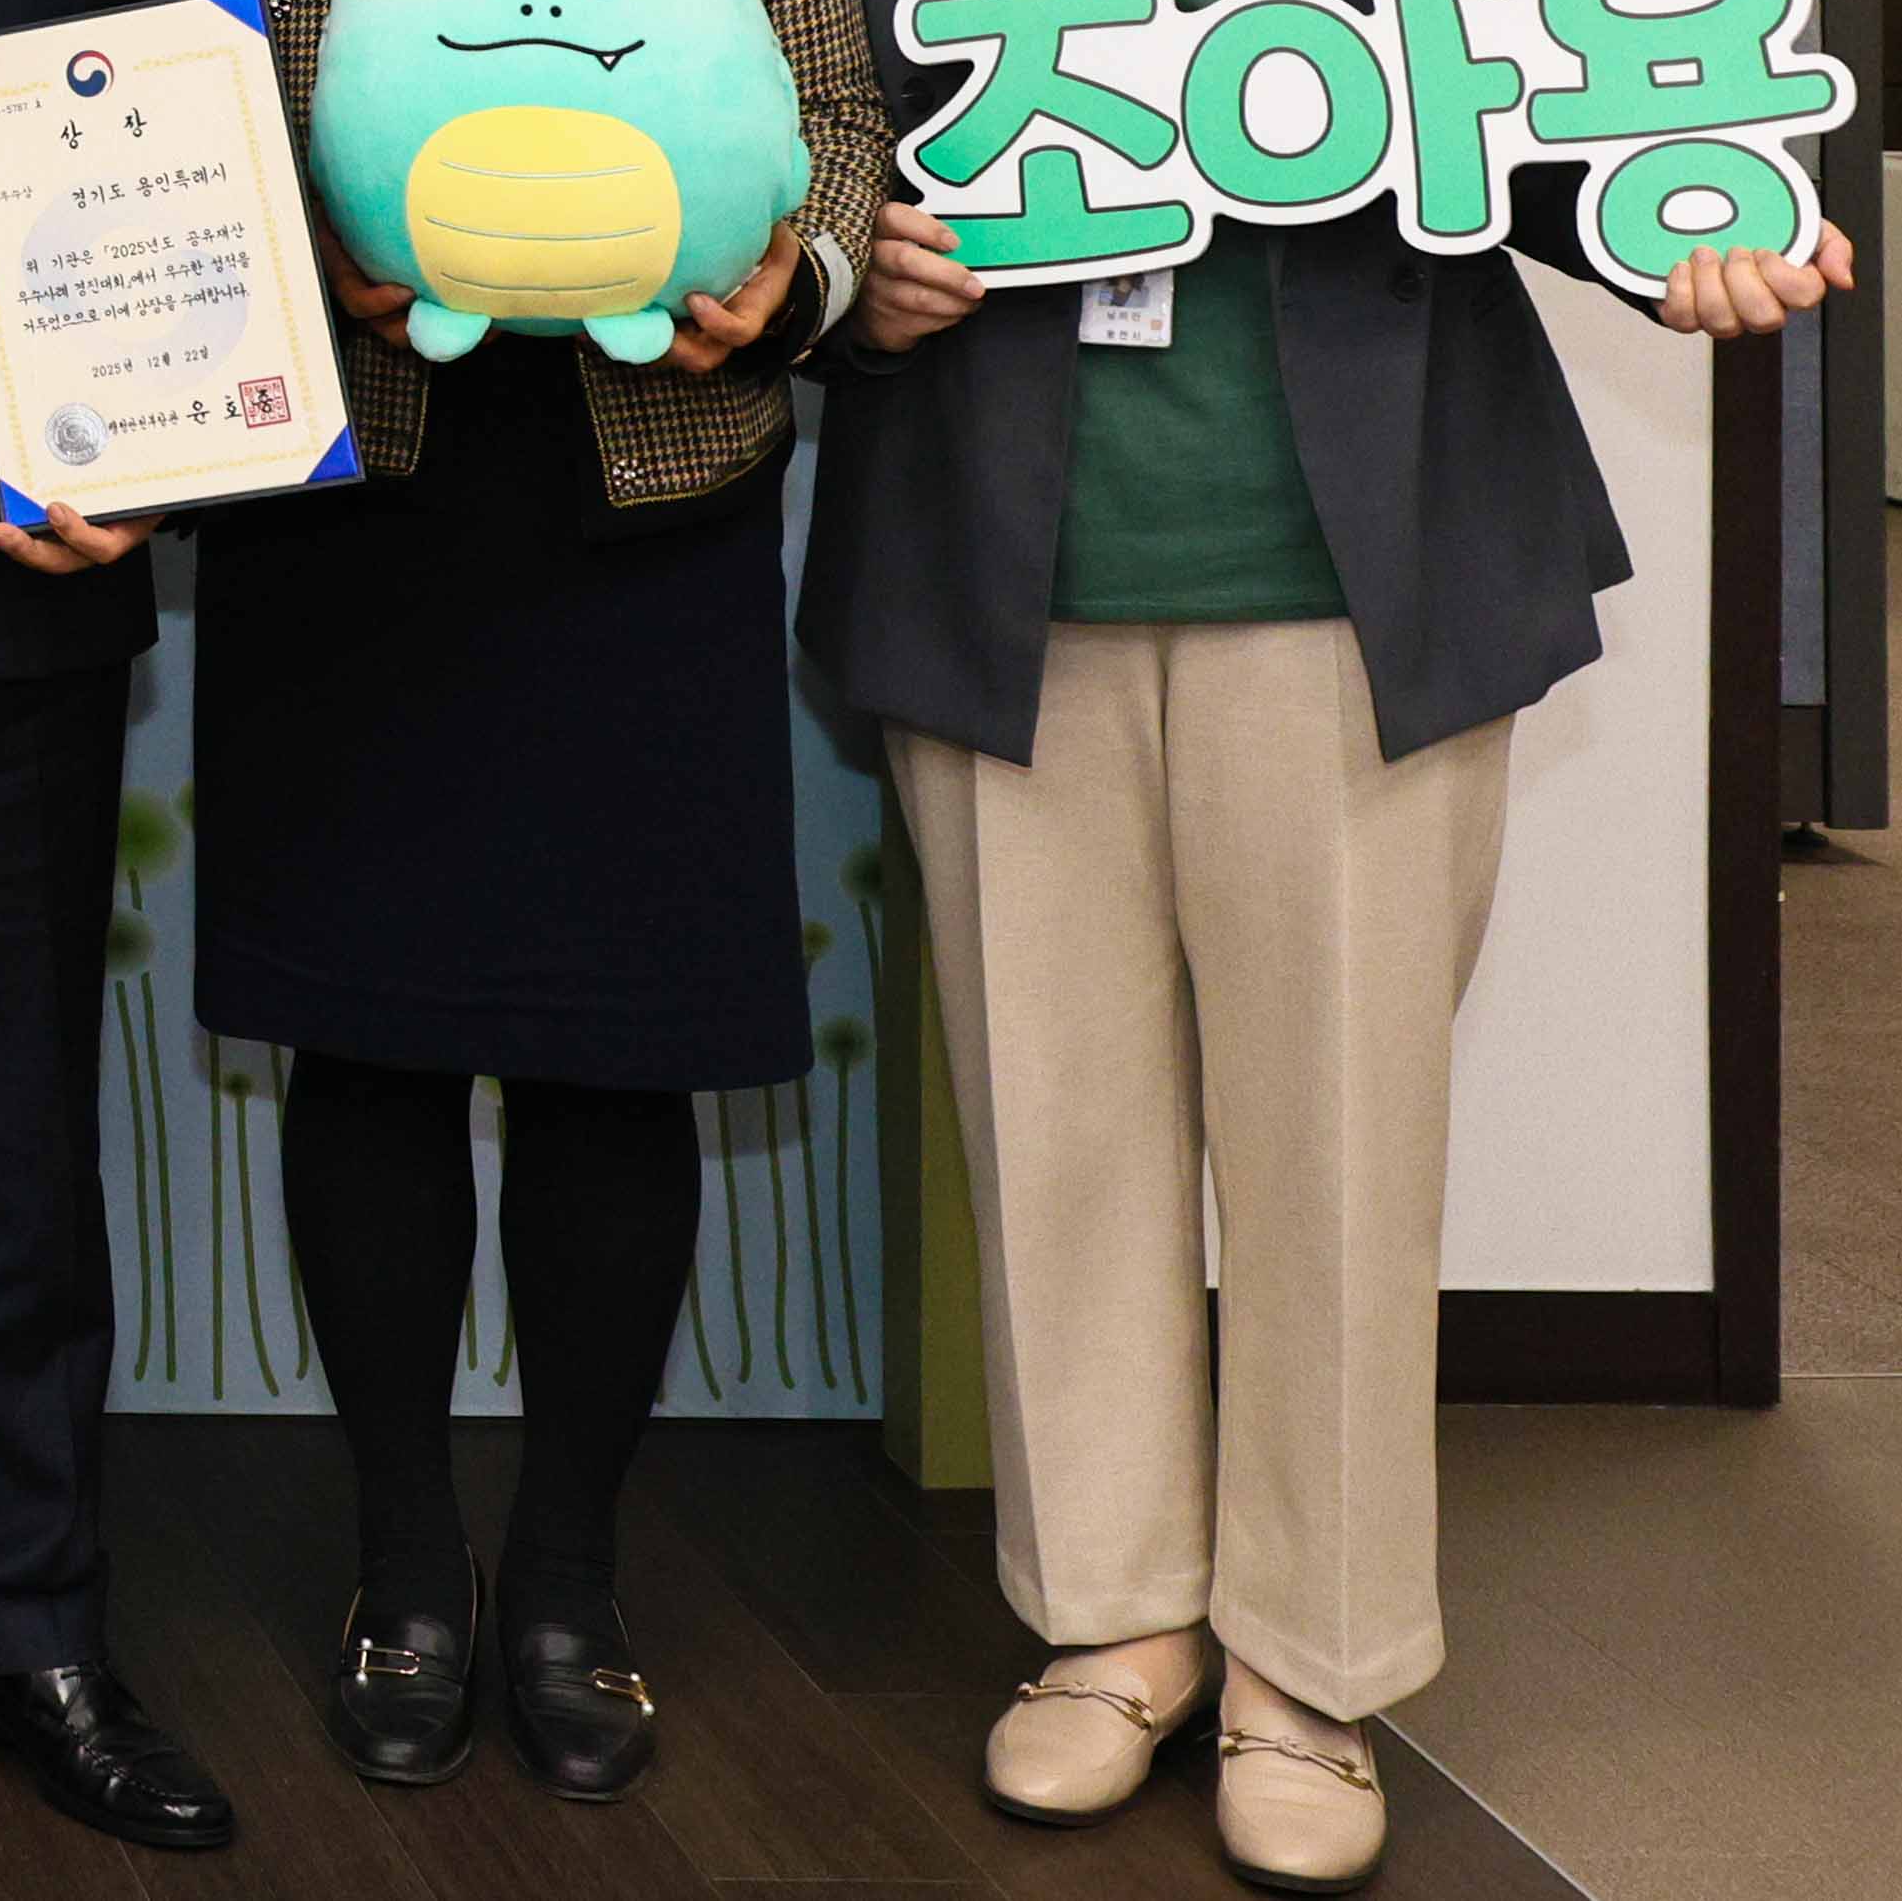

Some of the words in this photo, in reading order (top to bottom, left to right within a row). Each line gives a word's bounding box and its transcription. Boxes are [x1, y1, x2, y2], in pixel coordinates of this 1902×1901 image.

[60, 119, 83, 149] 상
[123, 107, 147, 137] 장
[71, 183, 125, 209] 경기도
[135, 162, 227, 198] 용인특례시
[26, 259, 39, 274] 위
[52, 249, 94, 269] 기관은
[186, 221, 245, 247] 공유재산
[17, 285, 69, 306] 우수사례
[164, 259, 205, 279] 우수한
[22, 308, 101, 334] 거두었으므로
[104, 304, 131, 320] 이에
[135, 294, 177, 316] 상장을
[92, 358, 134, 378] 2025년
